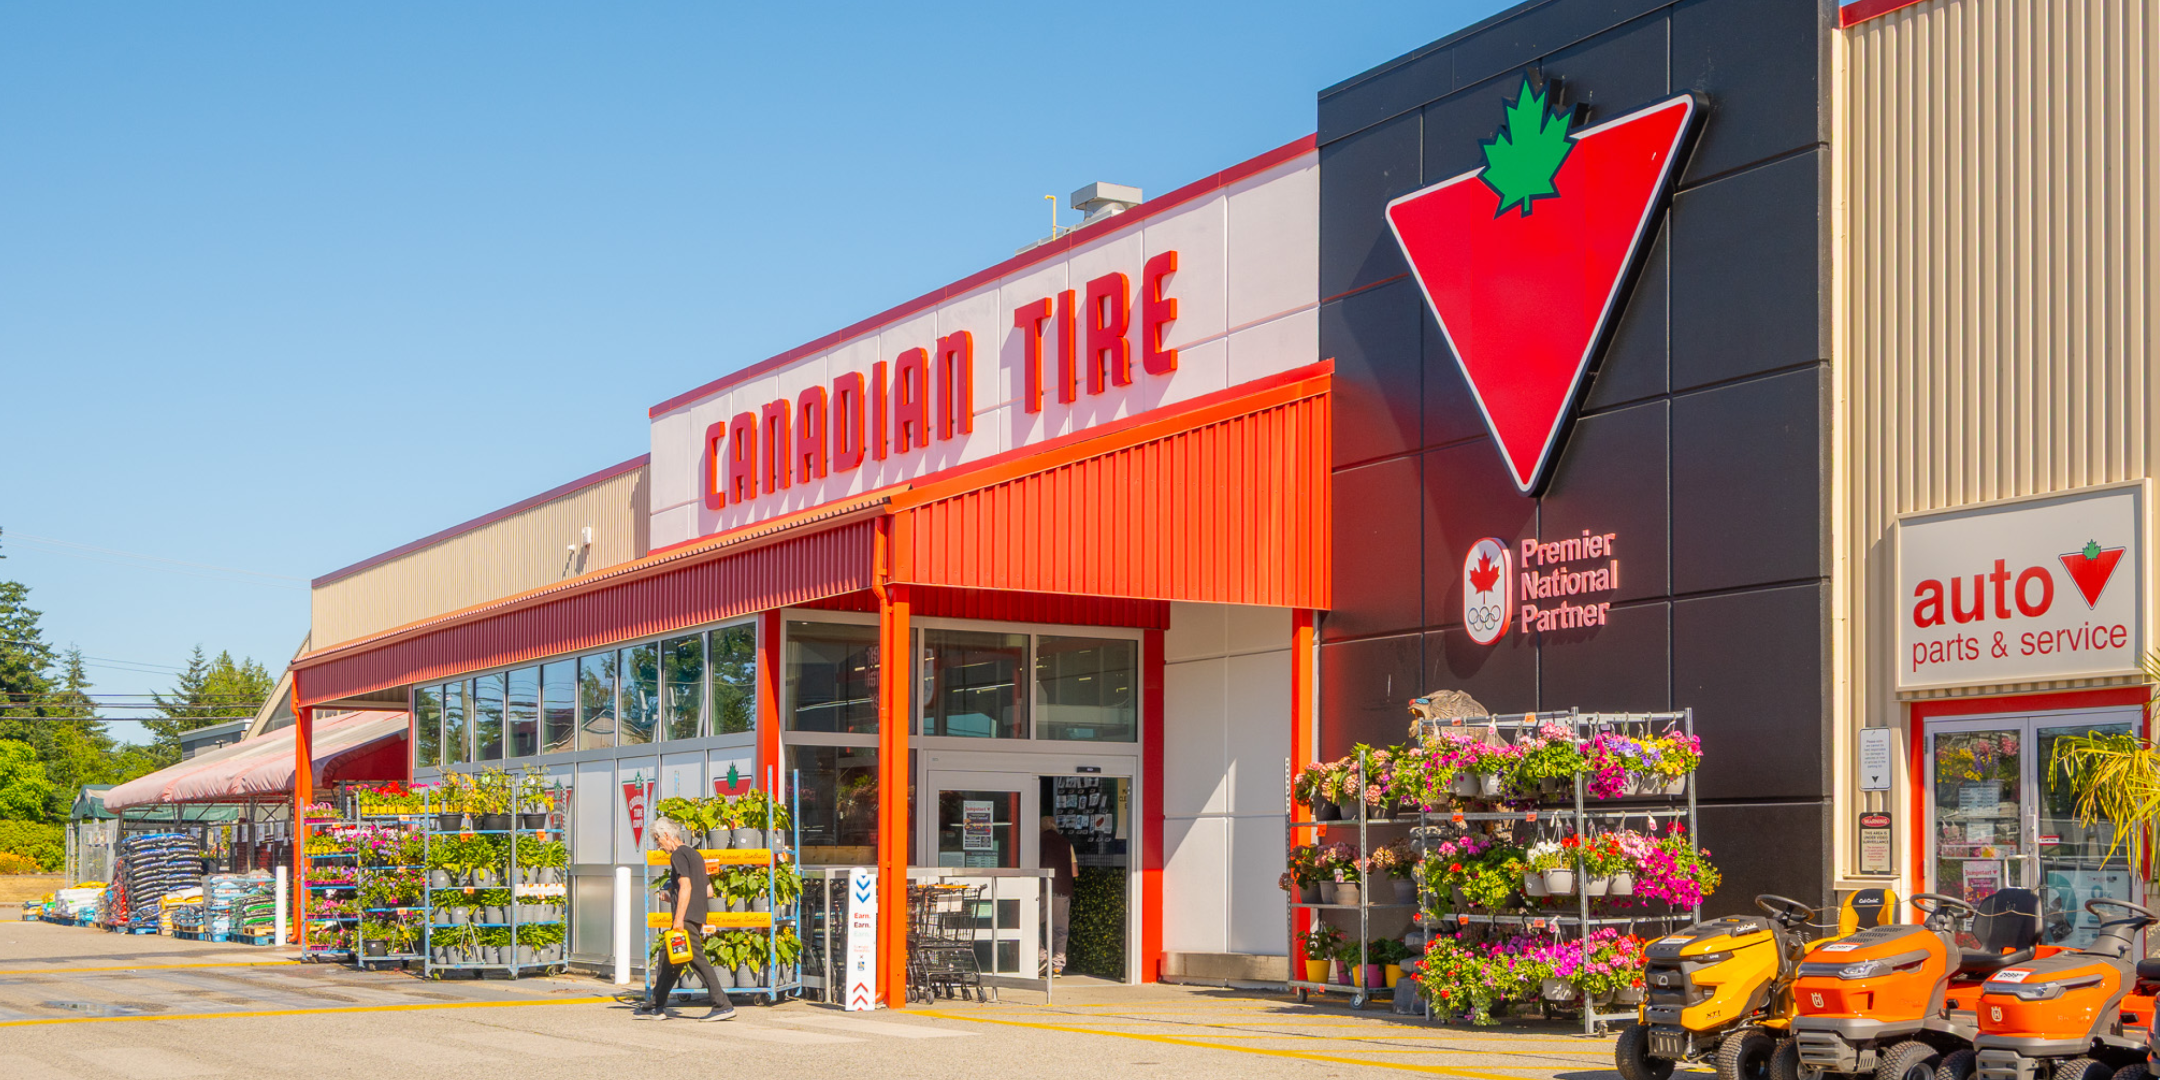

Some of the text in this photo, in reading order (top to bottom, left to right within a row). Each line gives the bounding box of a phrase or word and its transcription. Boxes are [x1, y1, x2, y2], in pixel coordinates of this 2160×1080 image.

[704, 250, 1178, 510] CANADIAN TIRE
[1521, 529, 1616, 568] Premier
[1521, 560, 1618, 601] National
[1913, 558, 2055, 628] auto
[1521, 600, 1611, 634] Partner
[1912, 621, 2128, 673] parts & service
